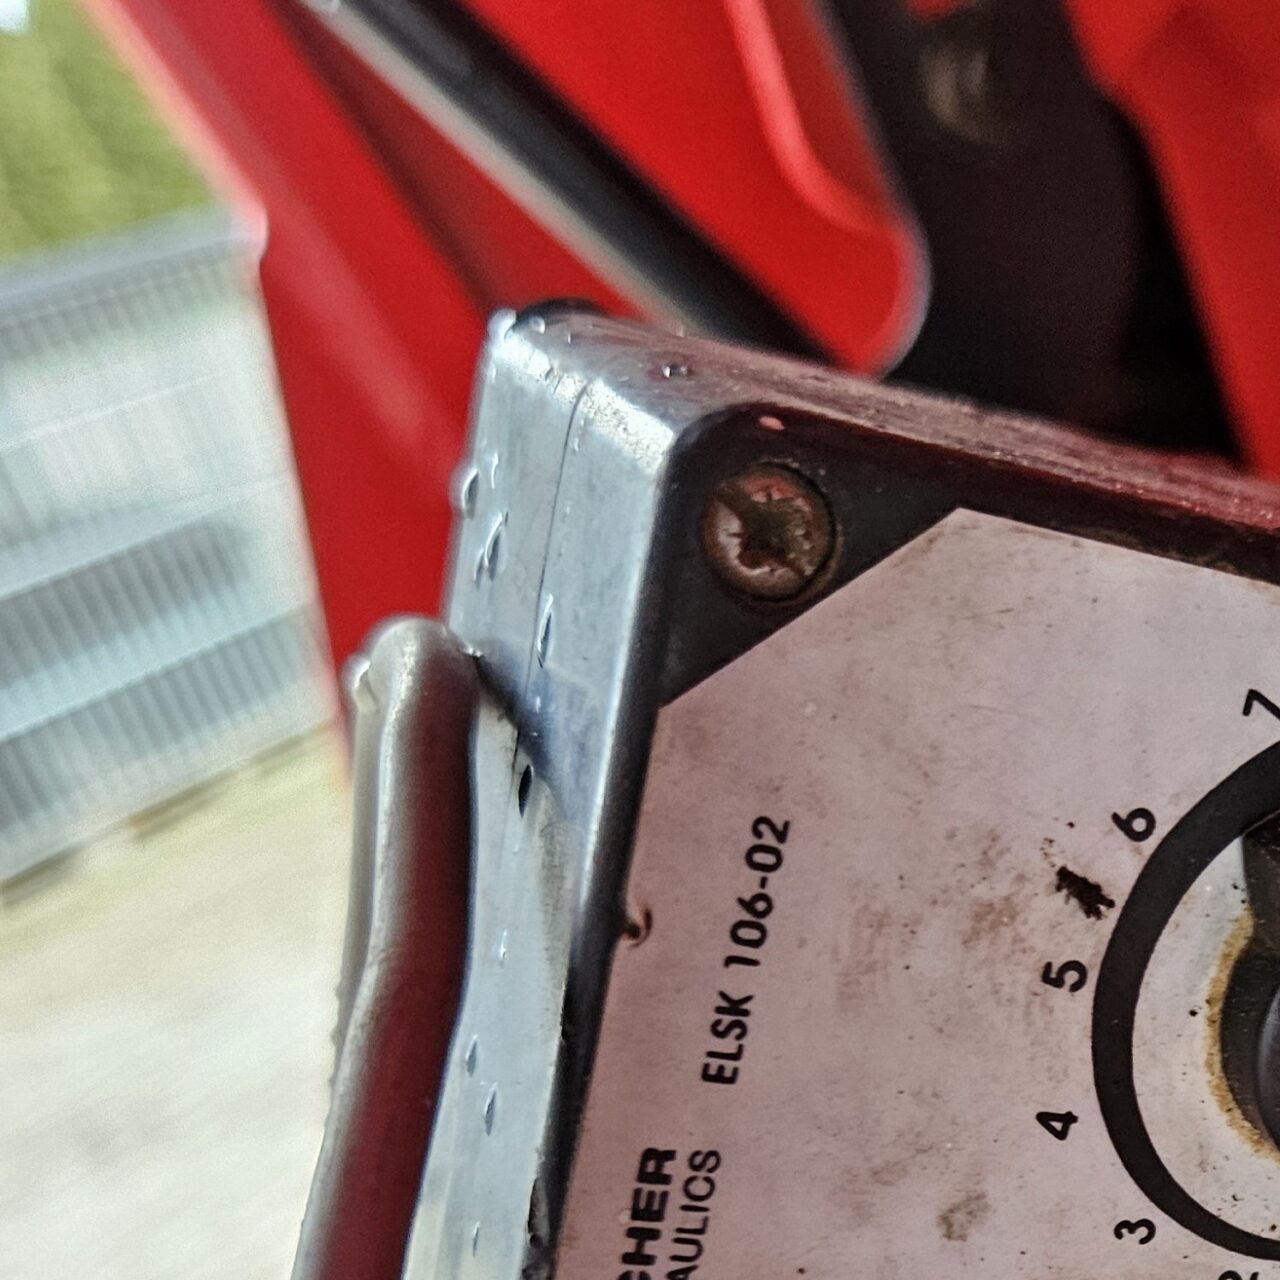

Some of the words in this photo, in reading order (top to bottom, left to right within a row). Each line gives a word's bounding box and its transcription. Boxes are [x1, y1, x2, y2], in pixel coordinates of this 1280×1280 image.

[1111, 807, 1157, 842] 6
[722, 812, 791, 969] 106-02
[1042, 960, 1088, 993] 5
[701, 990, 755, 1086] ELSK
[1036, 1110, 1078, 1141] 4
[1113, 1218, 1156, 1245] 3
